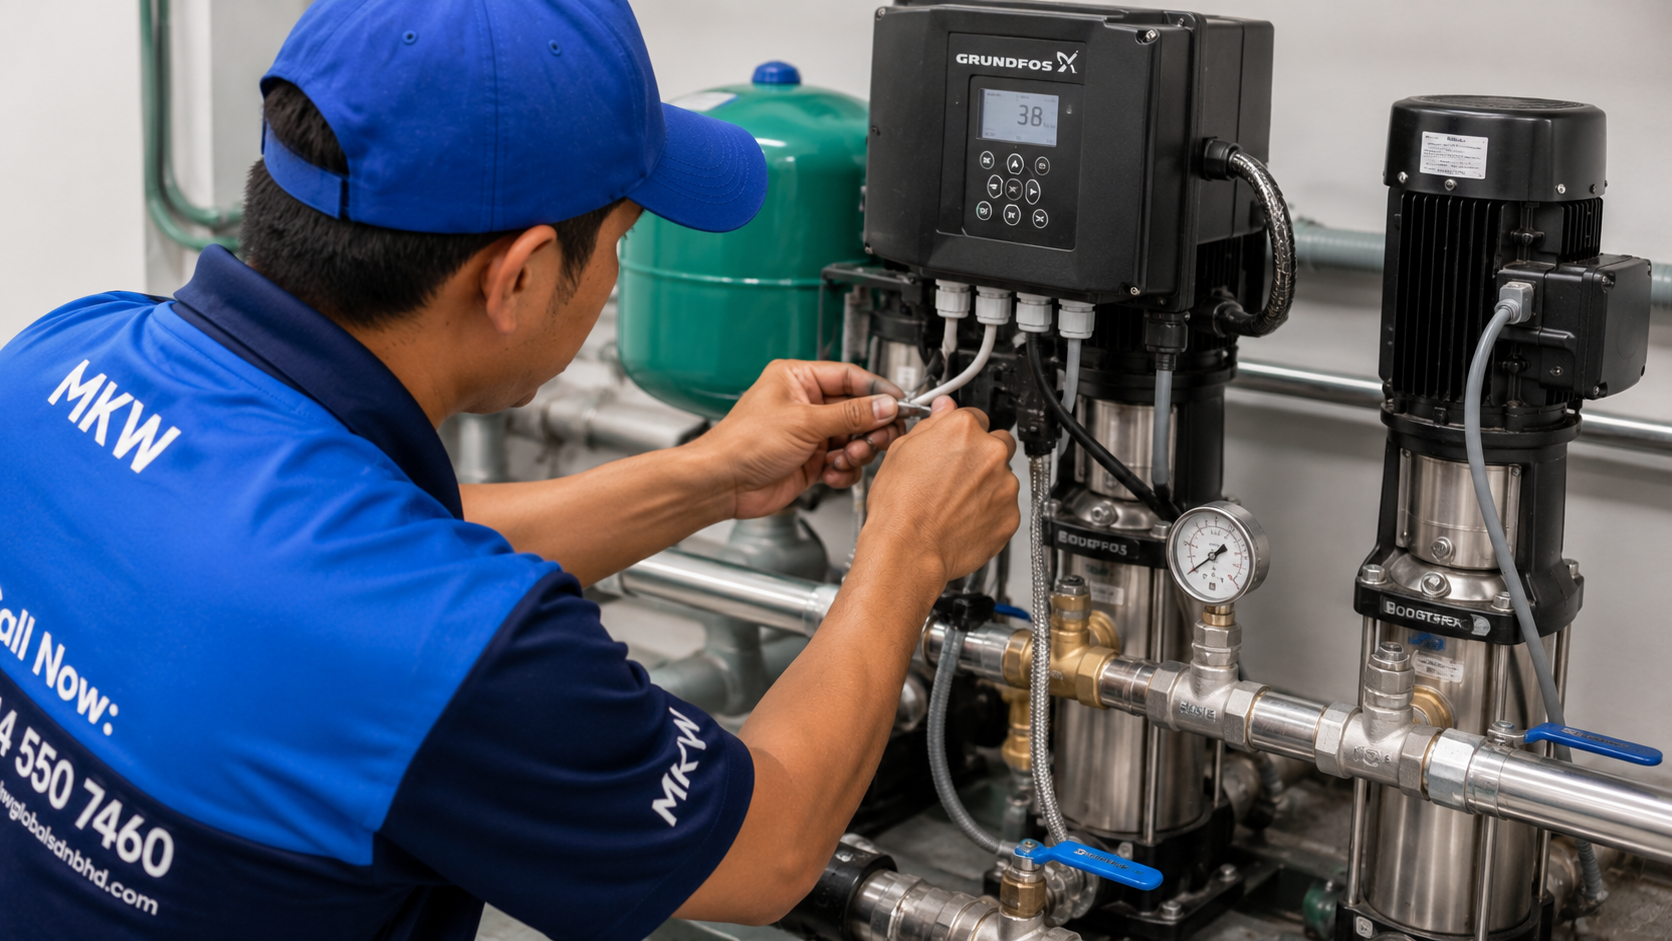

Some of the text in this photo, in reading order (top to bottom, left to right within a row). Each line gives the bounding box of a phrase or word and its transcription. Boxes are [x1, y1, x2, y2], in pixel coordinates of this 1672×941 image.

[955, 53, 1053, 72] GRUNDFOS
[1017, 104, 1043, 127] 38
[47, 358, 182, 474] MKW
[0, 585, 119, 736] all Now:
[15, 726, 75, 810] 550
[74, 777, 175, 878] 7460
[651, 706, 707, 827] MKW
